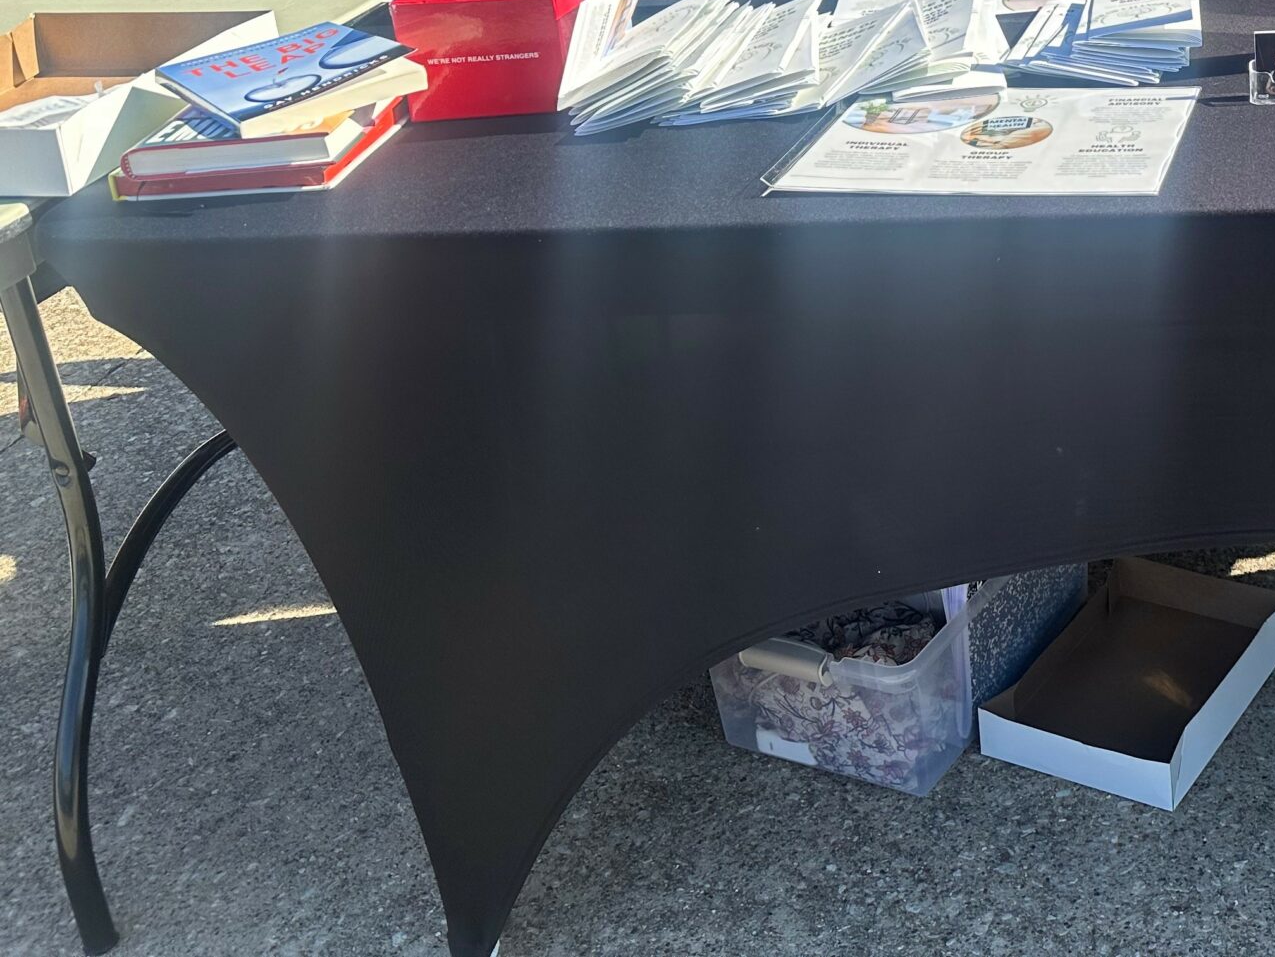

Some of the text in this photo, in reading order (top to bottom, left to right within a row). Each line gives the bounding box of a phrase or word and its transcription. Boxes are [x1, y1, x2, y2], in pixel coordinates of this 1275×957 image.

[183, 54, 264, 78] THE
[276, 28, 339, 54] BIG
[223, 42, 327, 79] LEAP
[427, 51, 540, 65] WE'RE NOT REALLY STRANGERS
[263, 54, 389, 110] GAY HENDRICKS
